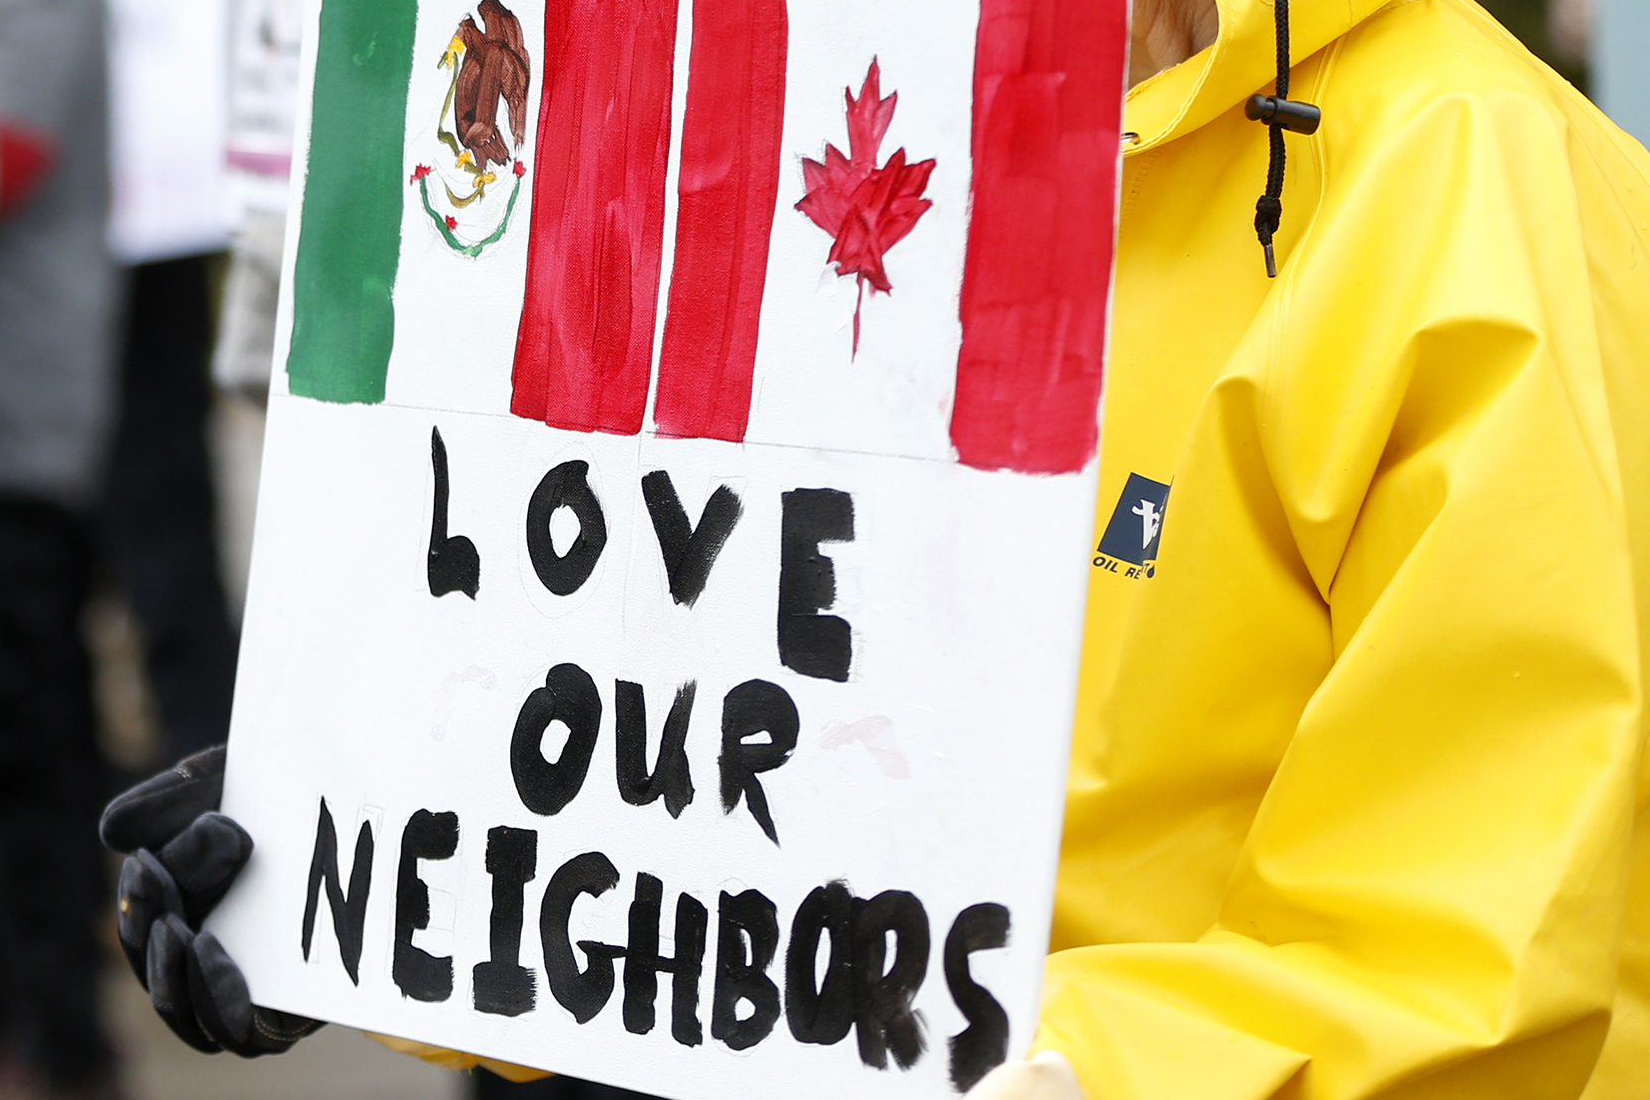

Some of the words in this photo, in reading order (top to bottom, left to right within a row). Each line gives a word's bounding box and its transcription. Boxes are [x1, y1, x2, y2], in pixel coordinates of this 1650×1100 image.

[426, 425, 856, 683] LOVE
[1092, 556, 1118, 573] OIL
[510, 662, 801, 847] OUR
[301, 795, 1011, 1094] NEIGHBORS
